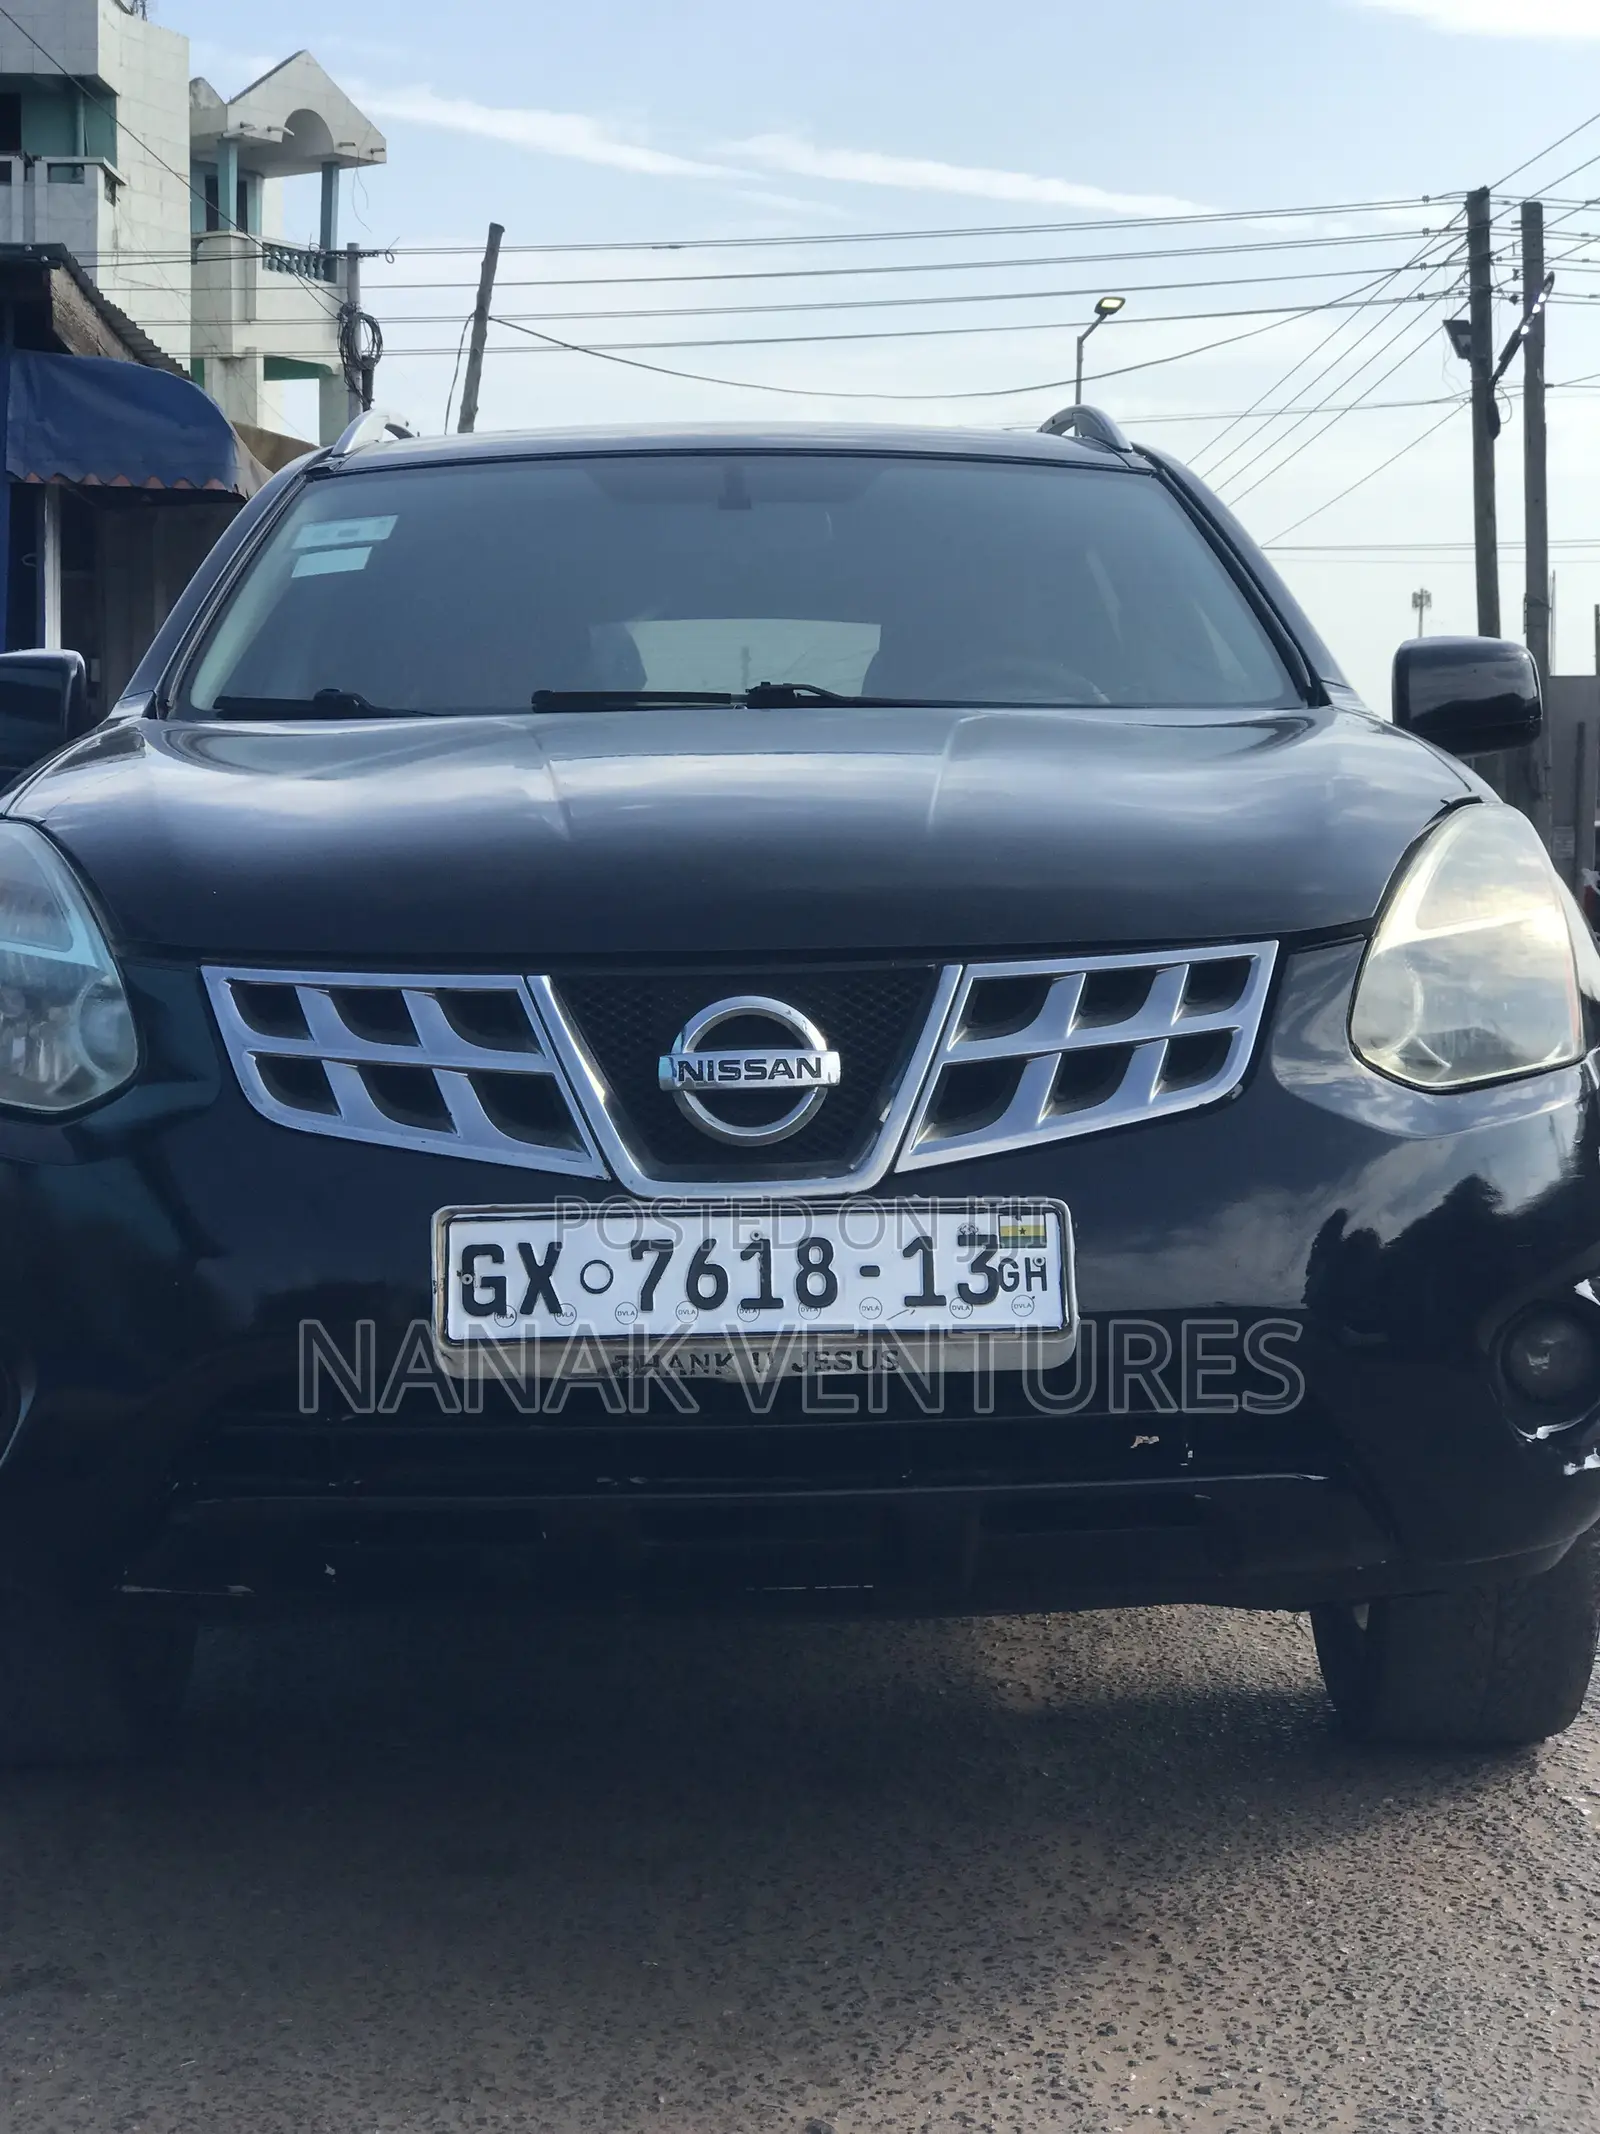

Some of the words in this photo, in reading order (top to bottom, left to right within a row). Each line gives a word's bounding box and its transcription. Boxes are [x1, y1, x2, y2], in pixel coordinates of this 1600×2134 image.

[678, 1057, 822, 1081] NISSAN
[461, 1241, 562, 1317] GX
[999, 1257, 1048, 1292] GH
[792, 1349, 899, 1374] JESUS
